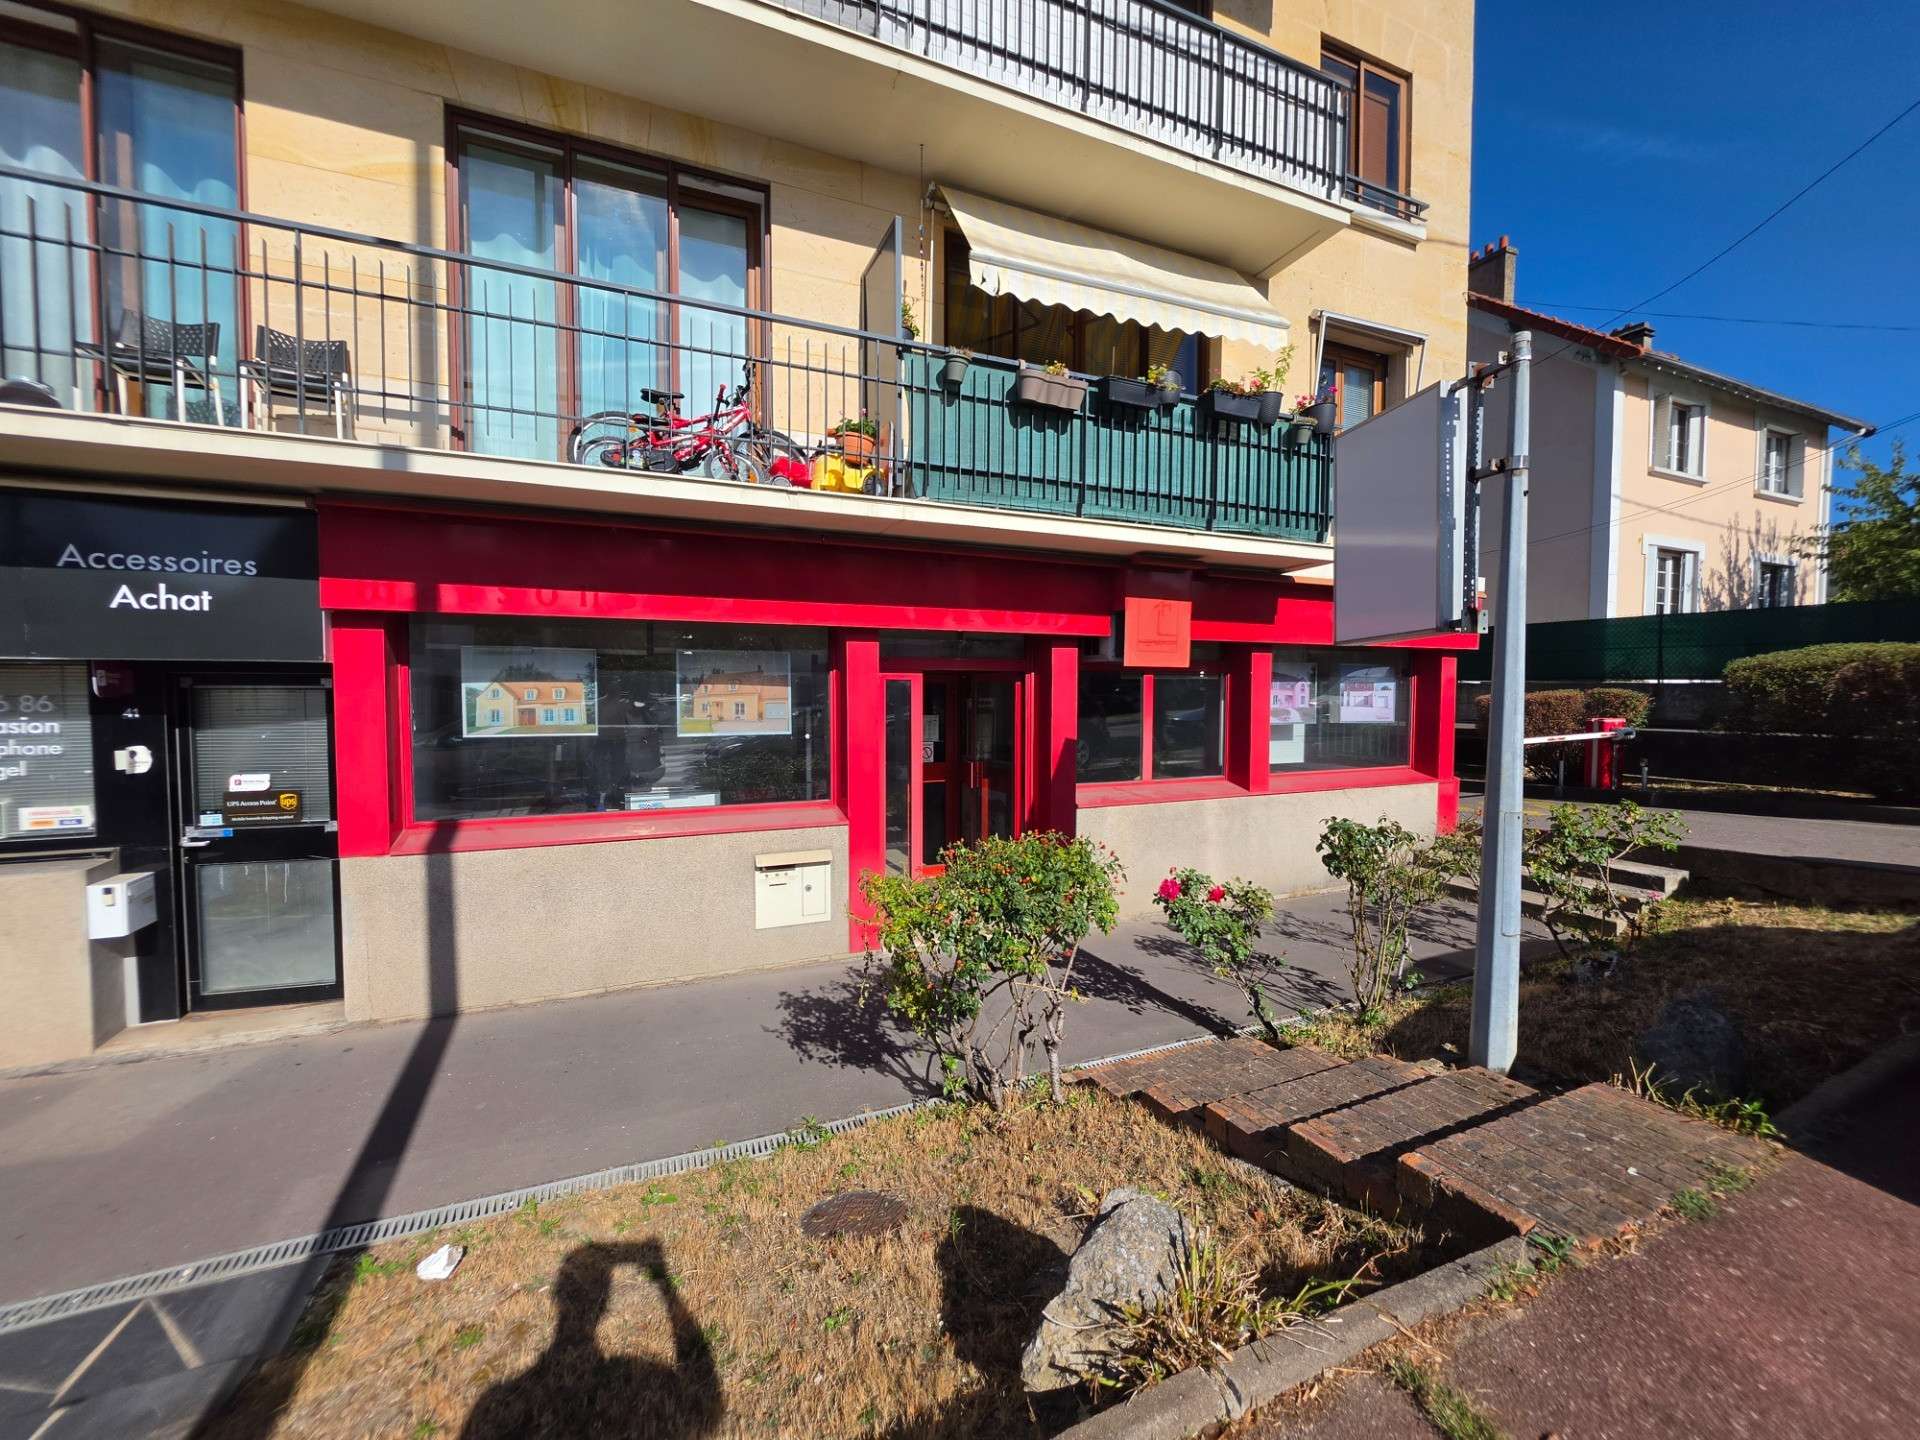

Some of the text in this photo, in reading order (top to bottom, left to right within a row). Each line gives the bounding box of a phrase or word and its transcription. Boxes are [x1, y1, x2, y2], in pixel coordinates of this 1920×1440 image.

[56, 543, 258, 576] Accessoires
[109, 582, 213, 612] Achat
[20, 694, 53, 713] 86
